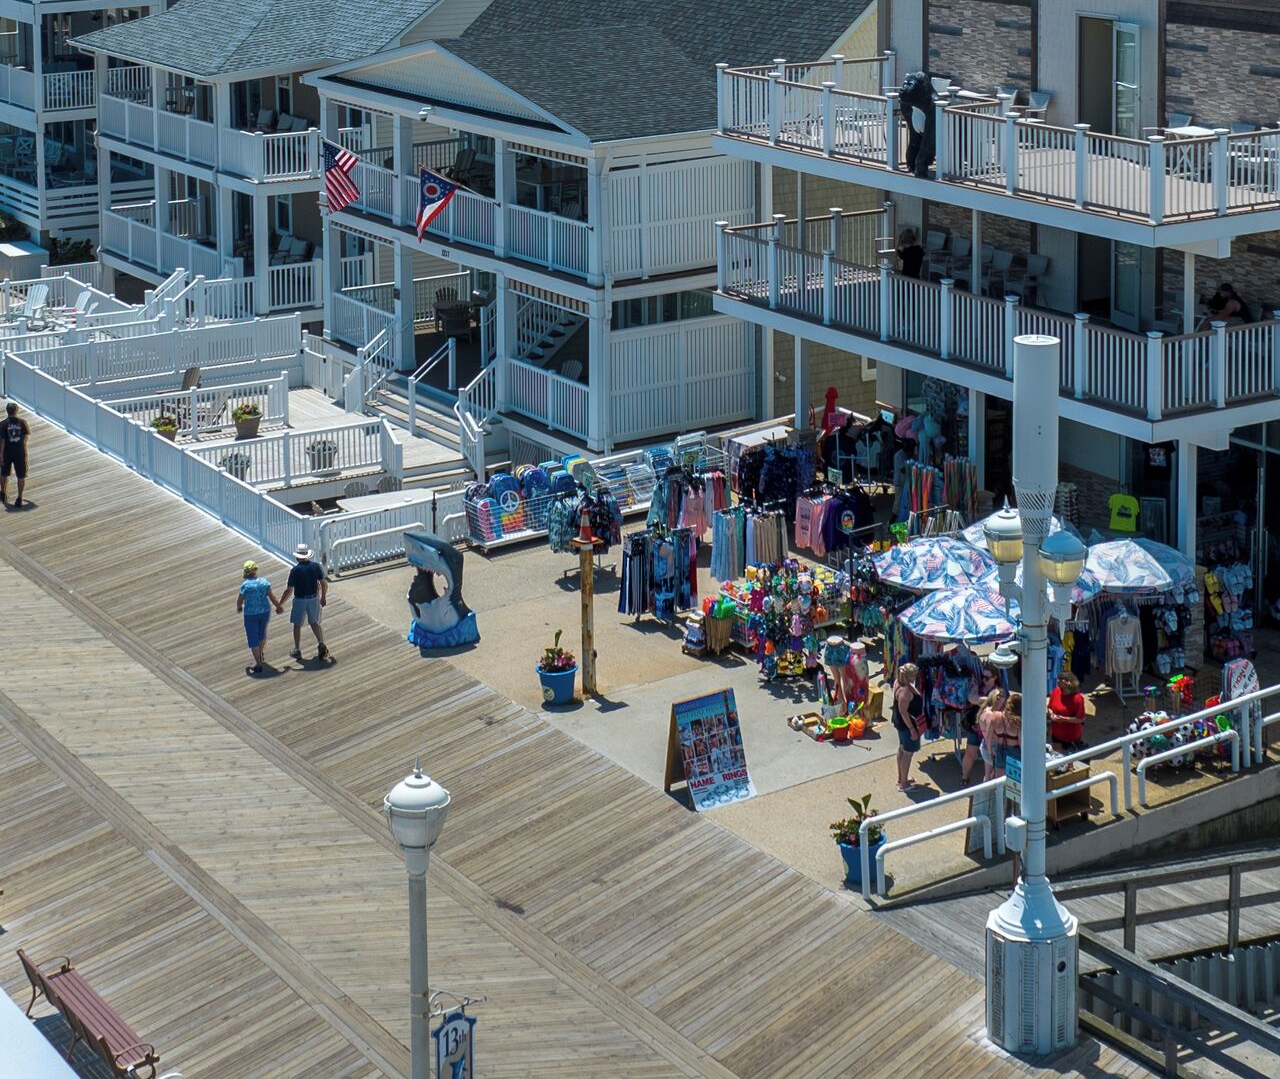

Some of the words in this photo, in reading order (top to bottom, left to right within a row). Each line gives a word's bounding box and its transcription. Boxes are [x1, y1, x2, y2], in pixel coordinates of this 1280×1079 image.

[690, 777, 715, 789] NAME
[722, 768, 748, 782] RINGS
[442, 1026, 467, 1058] 13th
